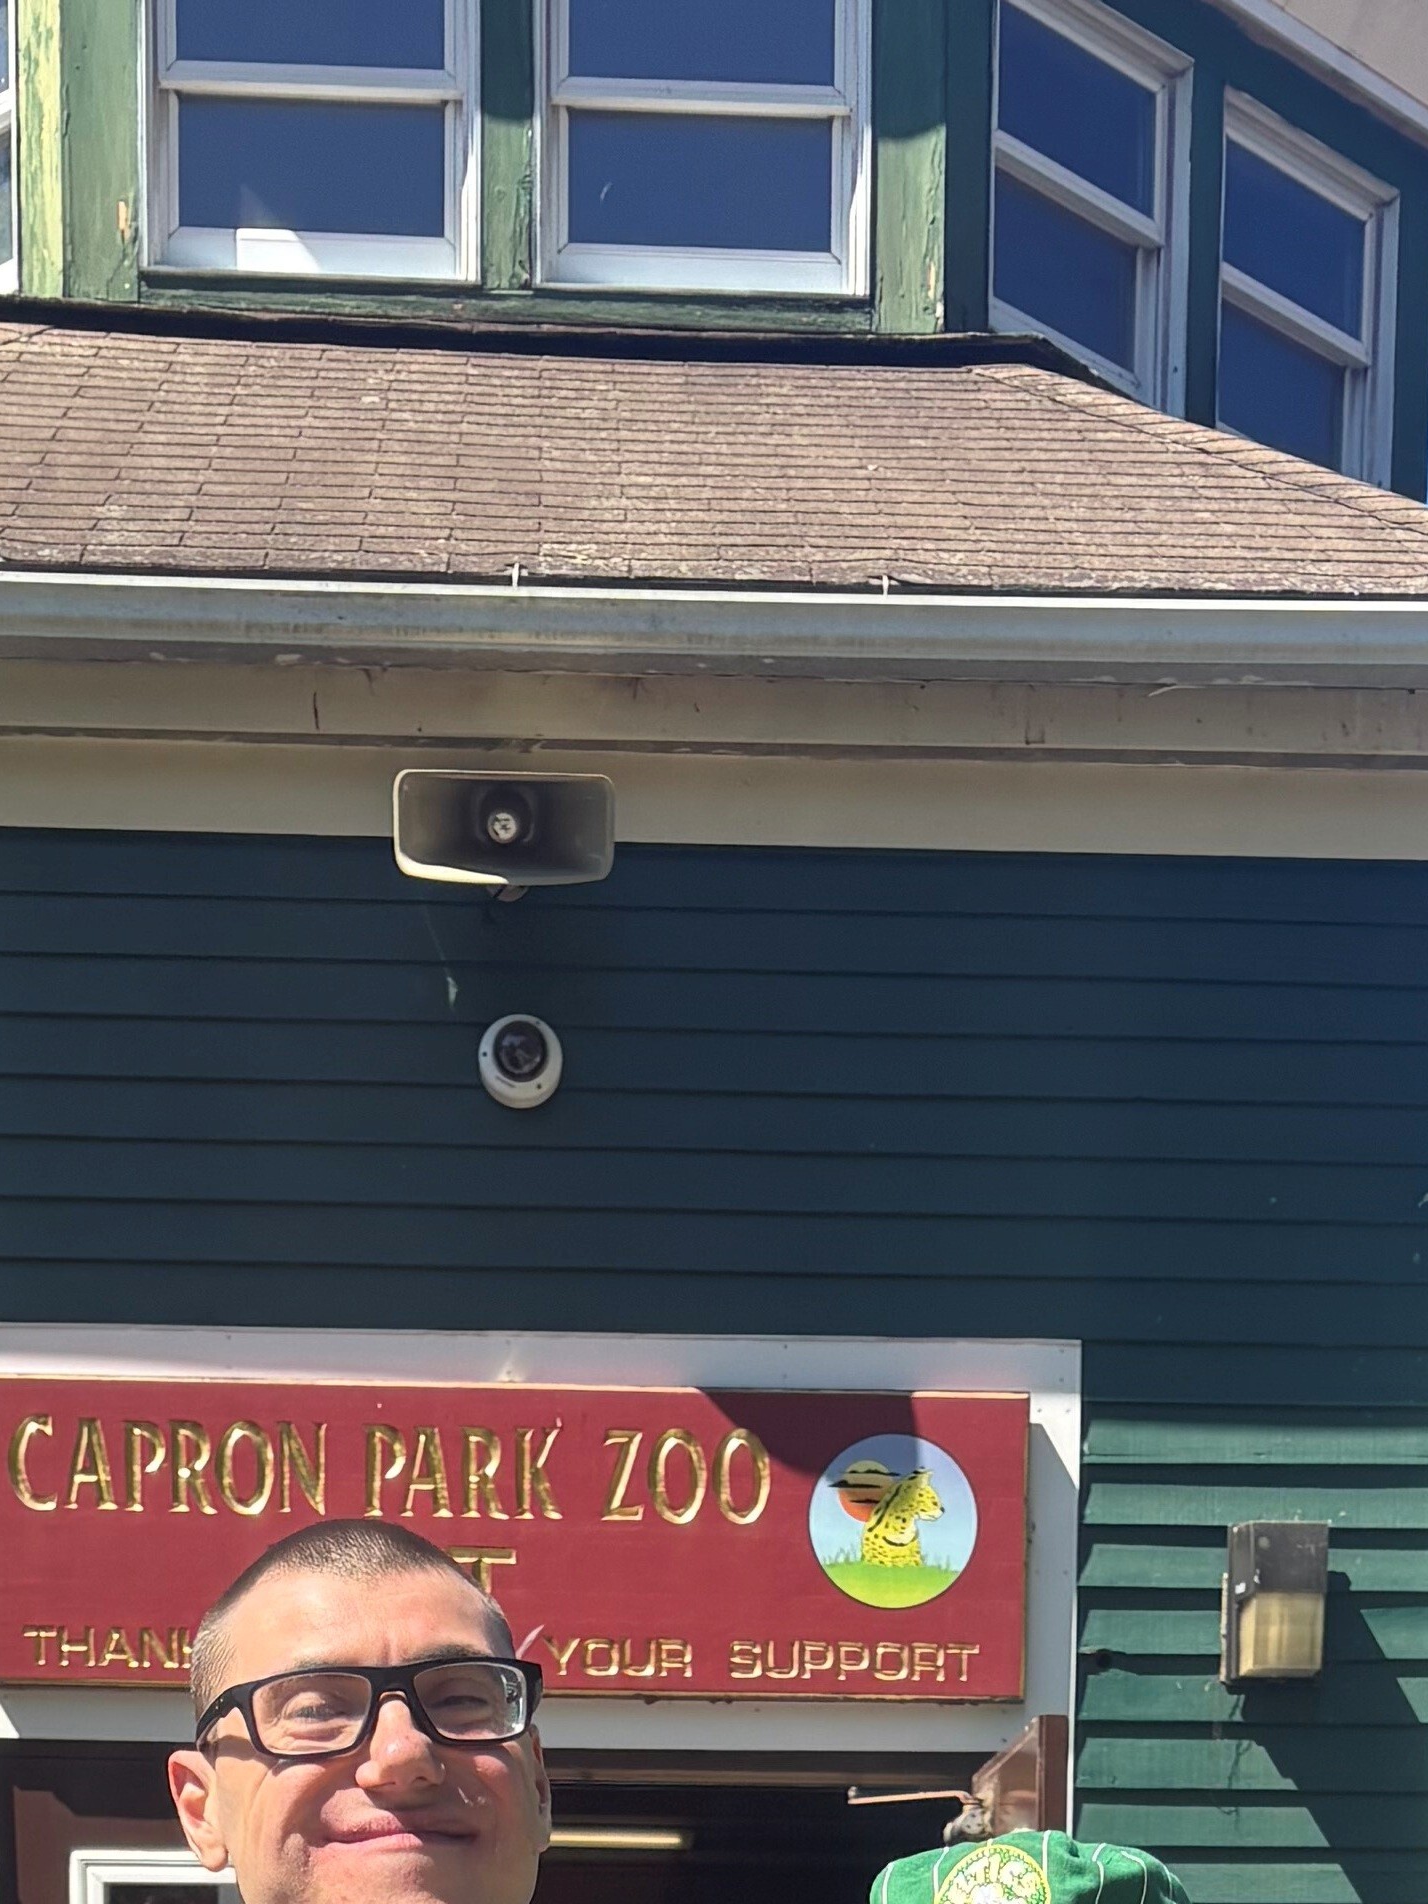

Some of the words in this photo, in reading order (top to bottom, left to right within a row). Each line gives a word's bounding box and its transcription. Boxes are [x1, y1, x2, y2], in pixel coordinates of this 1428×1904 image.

[7, 1413, 327, 1516] CAPRON
[363, 1423, 564, 1520] PARK
[601, 1428, 771, 1525] ZOO
[542, 1637, 693, 1677] YOUR
[730, 1641, 980, 1682] SUPPORT
